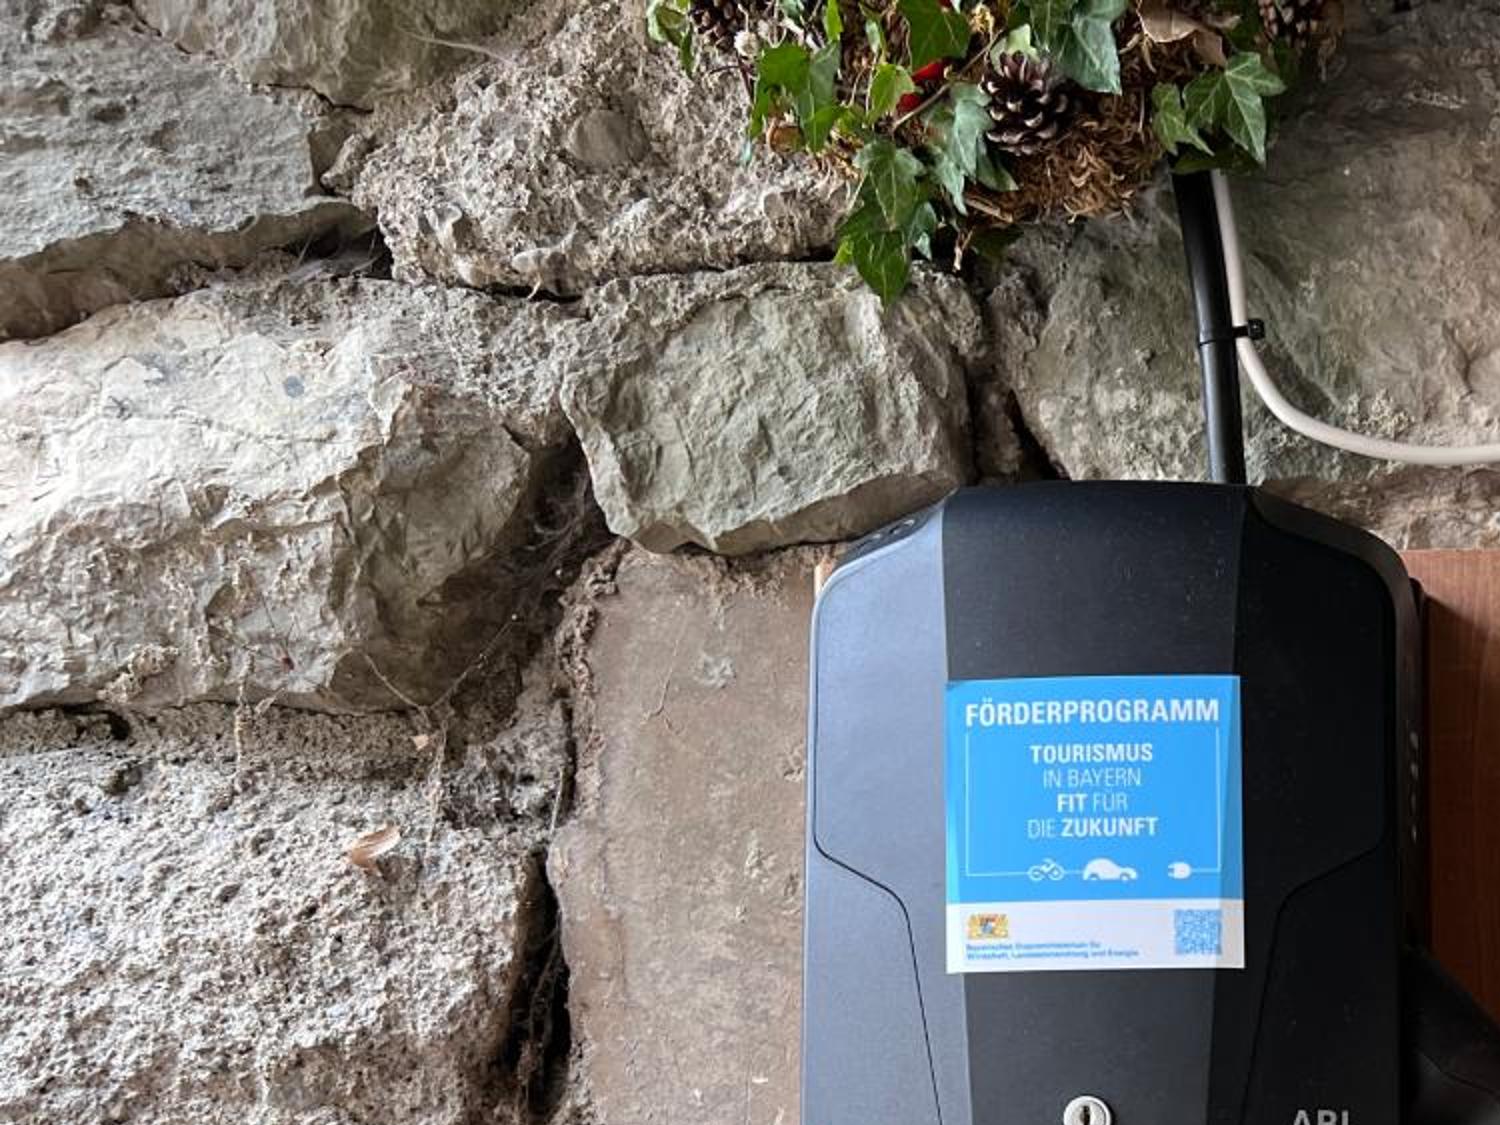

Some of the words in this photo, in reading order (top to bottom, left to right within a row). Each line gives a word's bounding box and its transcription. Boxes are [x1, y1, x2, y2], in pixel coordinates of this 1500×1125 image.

[965, 697, 1219, 727] FÖRDERPROGRAMM
[1030, 743, 1153, 764] TOURISMUS
[1043, 769, 1061, 788] IN
[1067, 767, 1142, 788] BAYERN
[1056, 793, 1088, 813] FIT
[1093, 790, 1128, 812] FÜR
[1027, 818, 1056, 839] DIE
[1061, 816, 1159, 837] ZUKUNFT
